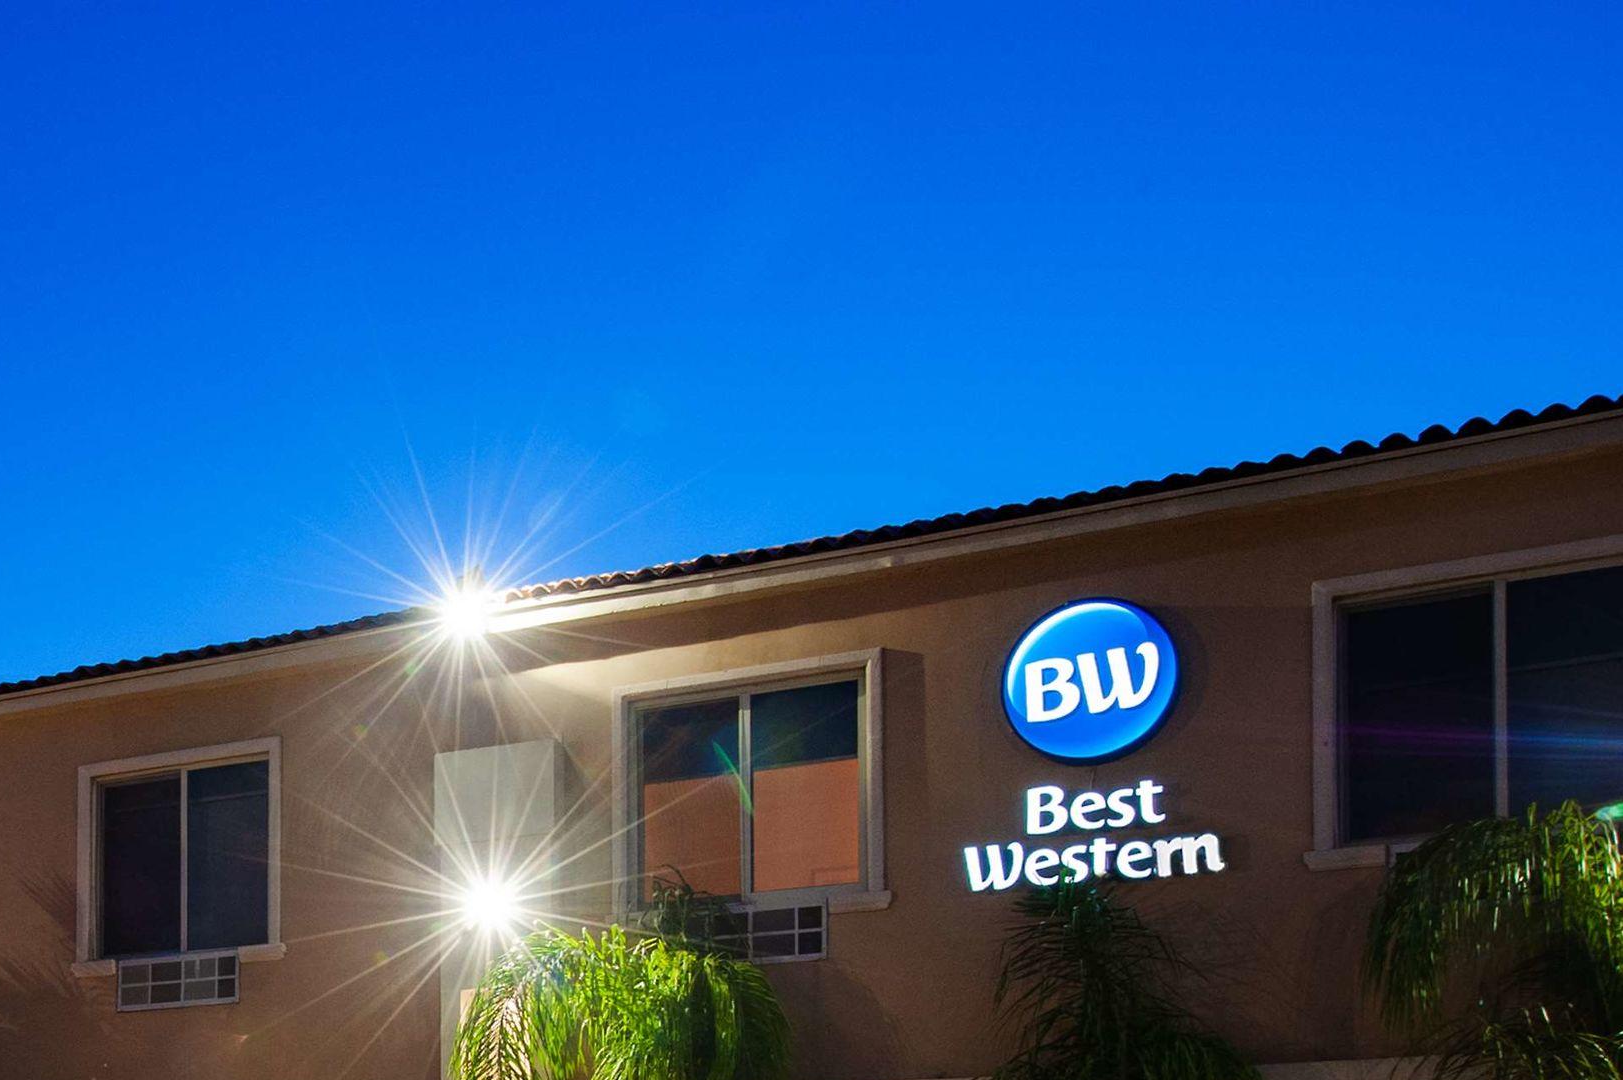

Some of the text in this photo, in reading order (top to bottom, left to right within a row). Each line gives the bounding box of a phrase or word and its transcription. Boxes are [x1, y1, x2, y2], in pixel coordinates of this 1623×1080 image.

[1025, 641, 1159, 723] BW
[1026, 779, 1166, 835] Best
[963, 833, 1225, 892] Western
